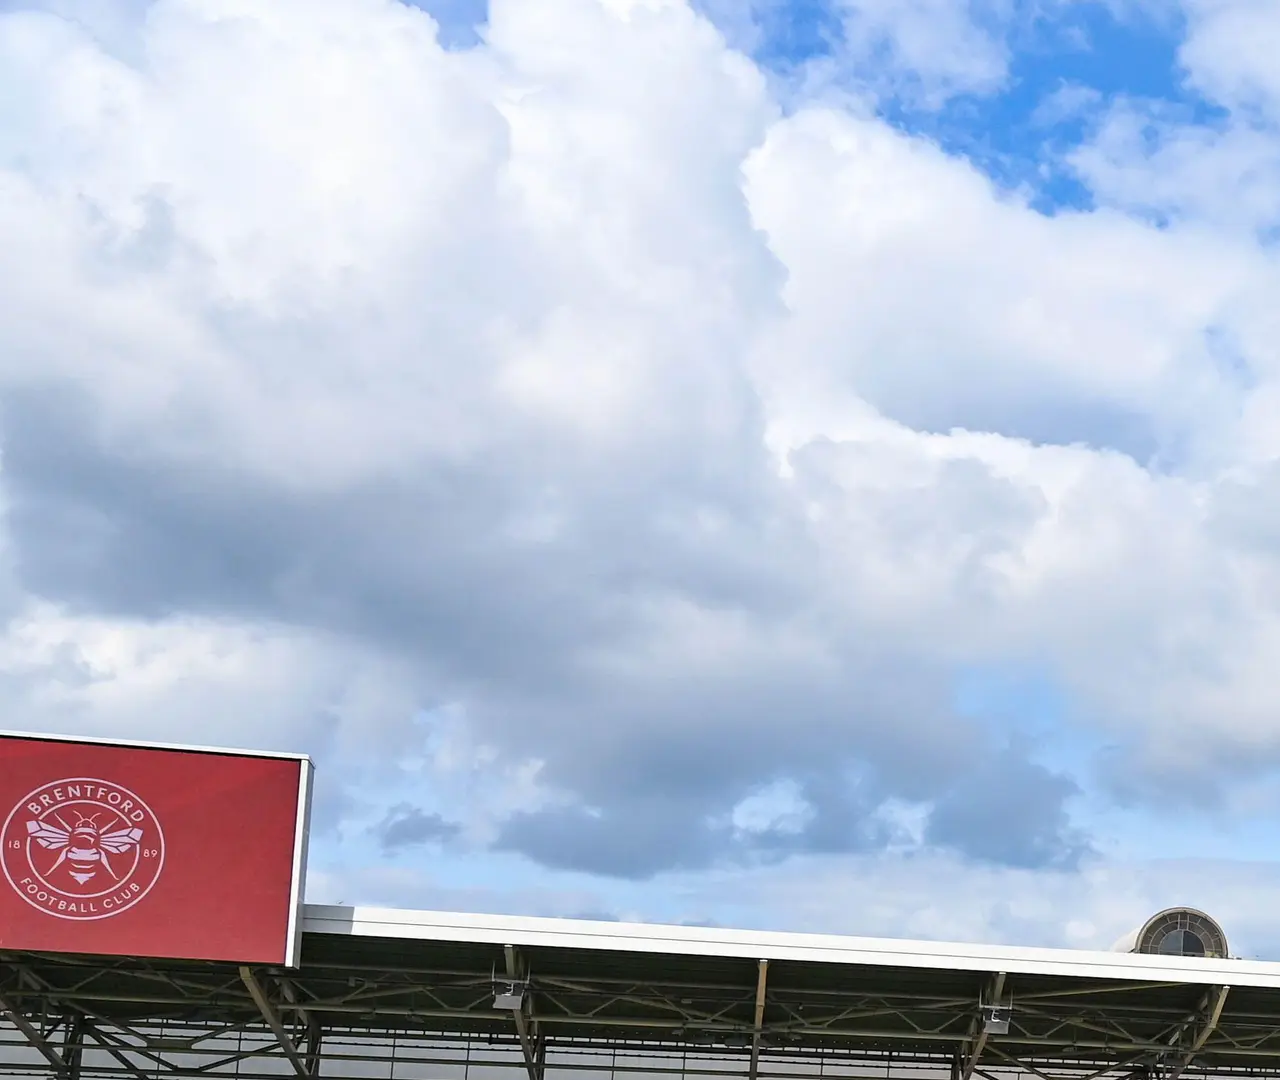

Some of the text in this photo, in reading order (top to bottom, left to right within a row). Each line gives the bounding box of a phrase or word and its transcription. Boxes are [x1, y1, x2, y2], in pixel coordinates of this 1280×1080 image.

[27, 784, 144, 823] BRENTFORD
[143, 849, 158, 858] 89
[20, 877, 140, 913] FOOTBALL CLUB
